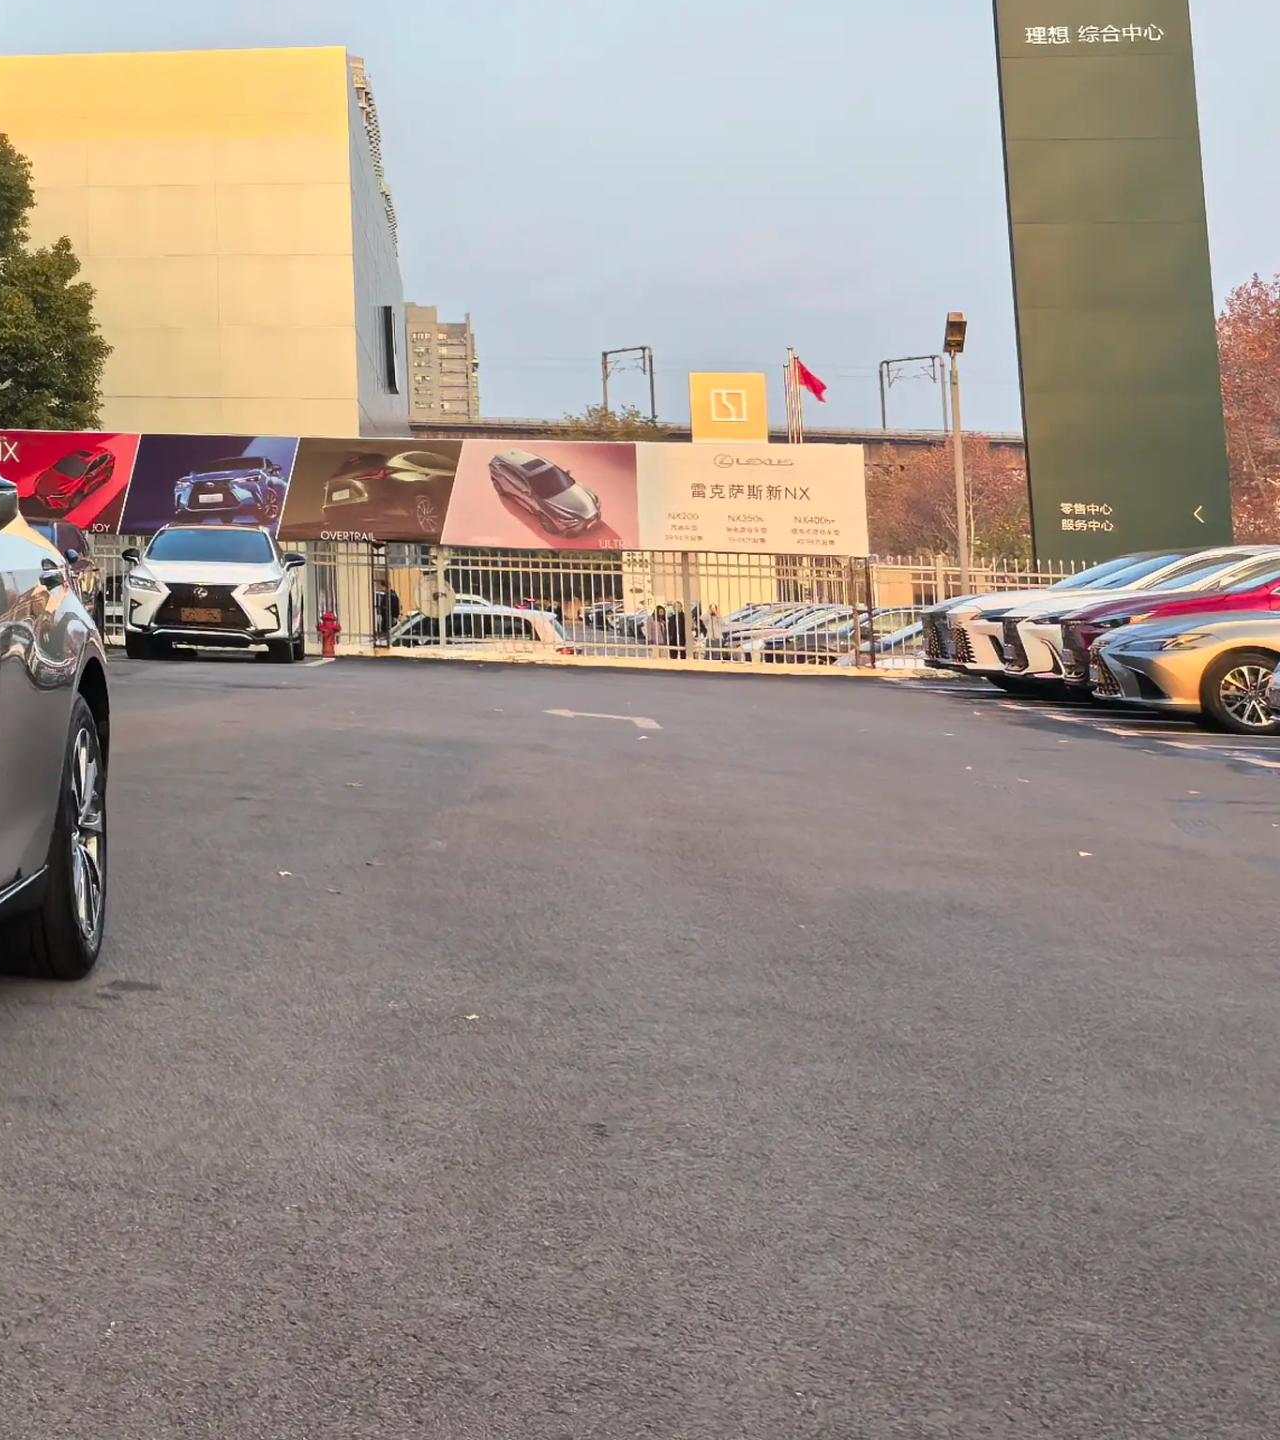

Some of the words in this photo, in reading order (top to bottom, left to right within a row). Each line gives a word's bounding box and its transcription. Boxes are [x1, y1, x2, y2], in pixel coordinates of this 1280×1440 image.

[1025, 25, 1070, 45] 理想
[1078, 24, 1164, 43] 综合中心
[736, 457, 794, 466] LEXUS
[690, 482, 811, 501] 雷克萨斯新NX
[1060, 502, 1113, 515] 零售中心
[1061, 519, 1114, 532] 服务中心
[320, 530, 377, 542] OVERTRAIL
